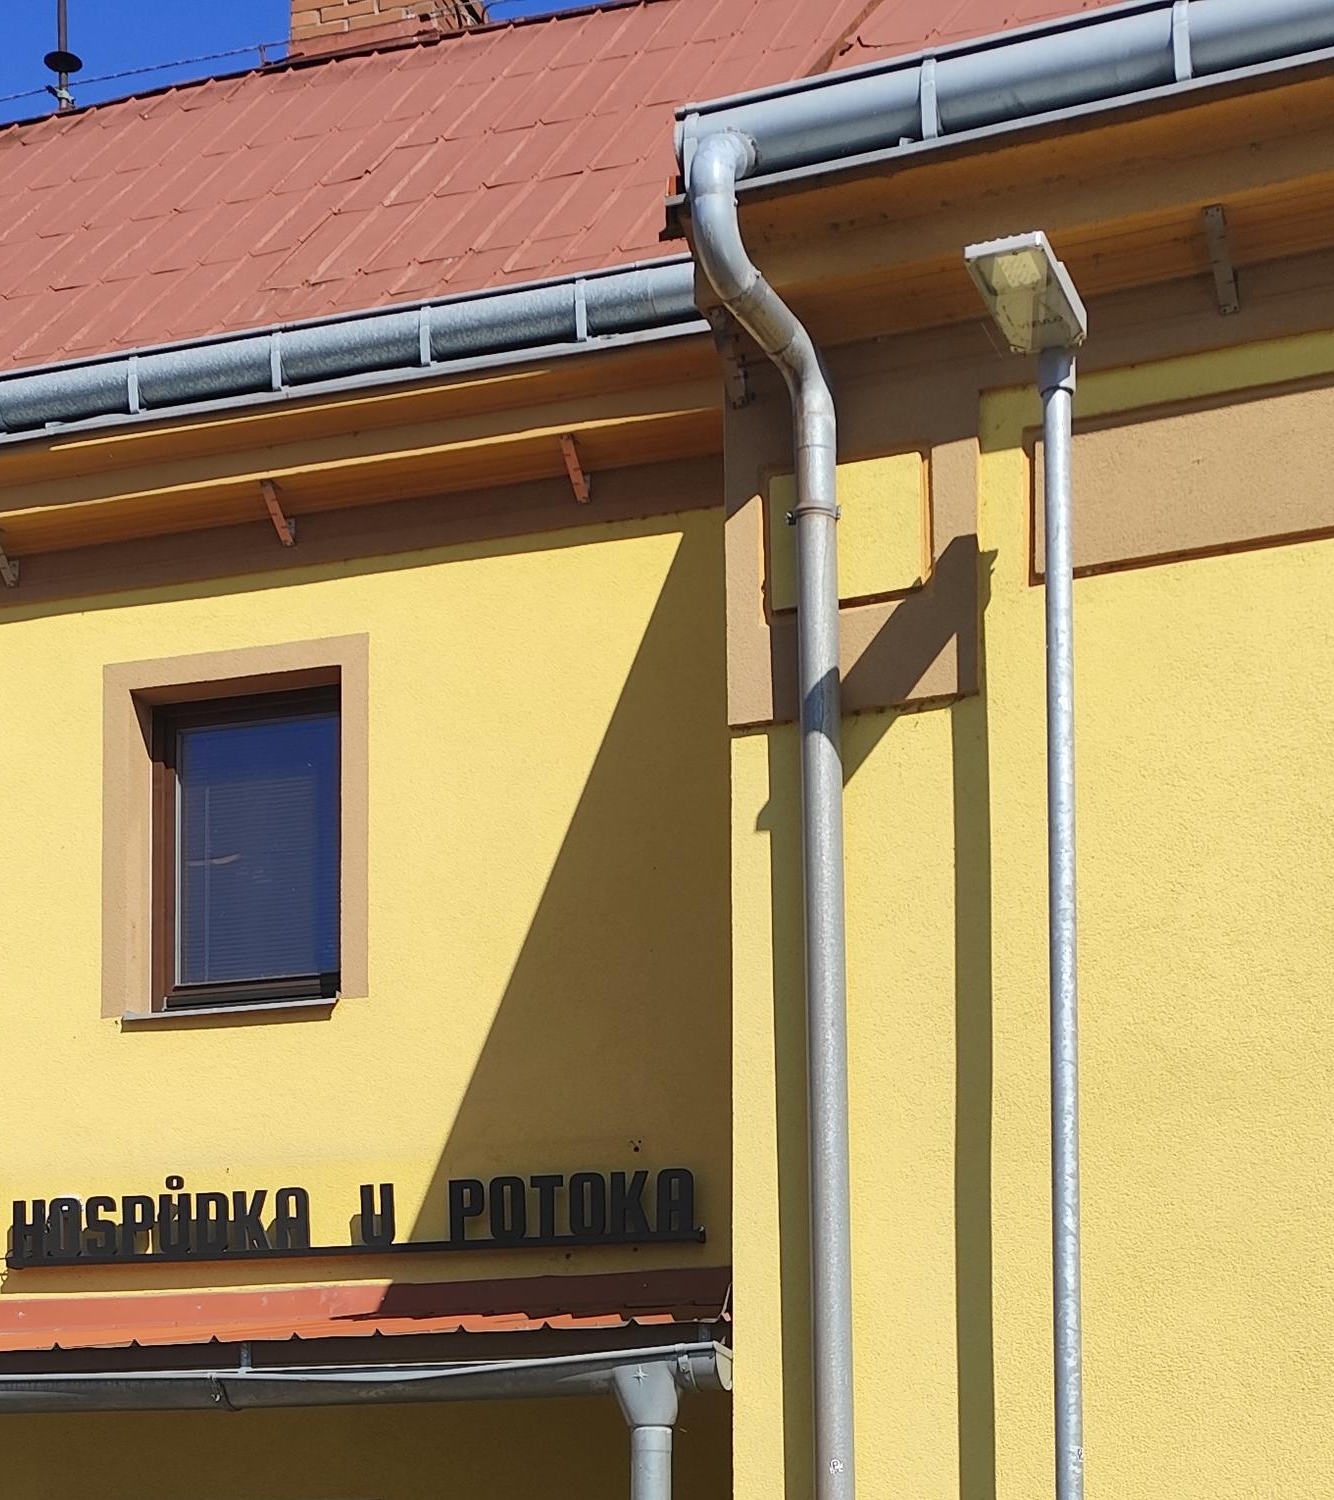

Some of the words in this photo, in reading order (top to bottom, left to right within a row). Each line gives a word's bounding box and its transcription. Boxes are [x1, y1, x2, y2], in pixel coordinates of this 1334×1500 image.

[13, 1175, 311, 1258] HOSPŮDKA
[359, 1183, 394, 1245] U
[448, 1168, 696, 1242] POTOKA
